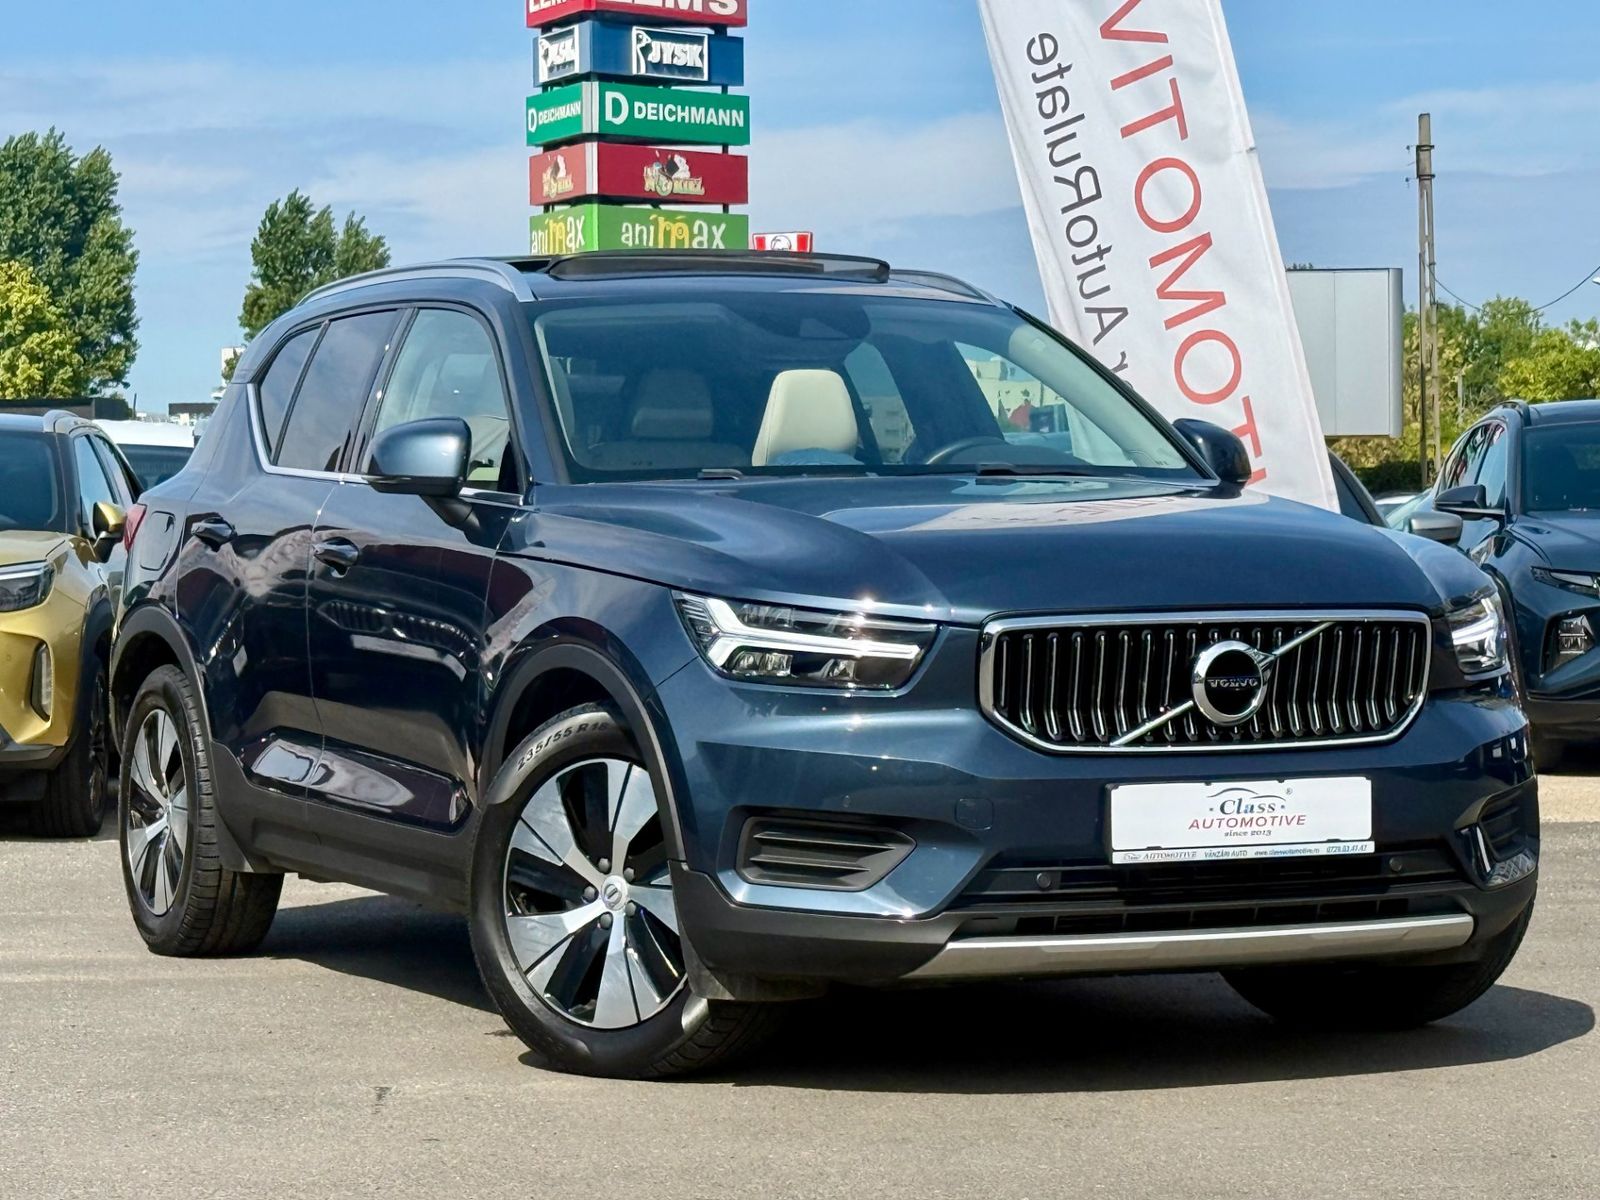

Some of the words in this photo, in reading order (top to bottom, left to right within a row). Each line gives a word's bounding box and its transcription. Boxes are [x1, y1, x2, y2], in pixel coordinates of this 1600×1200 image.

[648, 41, 703, 67] JYSK
[538, 101, 582, 126] DEICHMANN
[605, 91, 629, 125] D
[634, 102, 744, 128] DEICHMANN
[531, 215, 586, 256] animax
[621, 214, 727, 249] animax
[1208, 679, 1258, 688] VOLVO
[517, 728, 574, 771] 235/55
[1219, 798, 1276, 815] Class
[1188, 815, 1307, 830] AUTOMOTIVE
